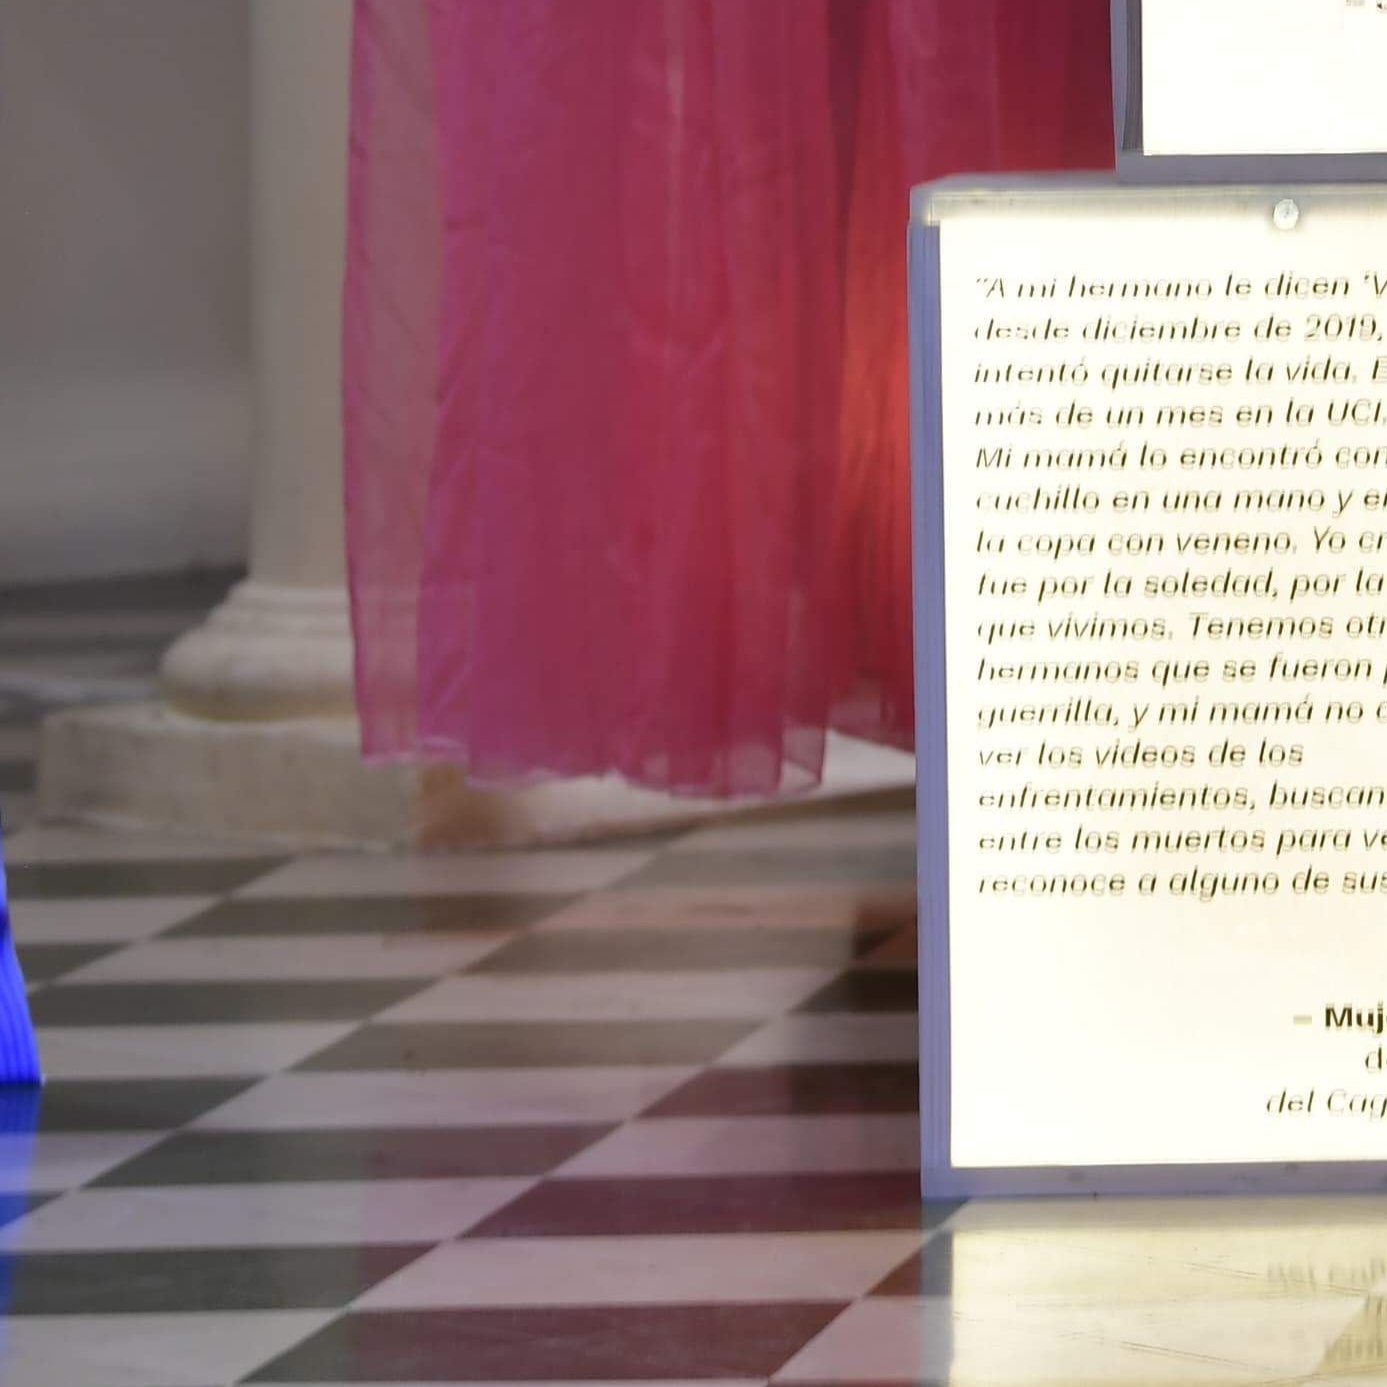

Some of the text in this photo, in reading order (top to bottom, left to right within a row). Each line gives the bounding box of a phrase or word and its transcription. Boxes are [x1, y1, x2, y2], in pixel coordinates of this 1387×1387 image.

[1067, 273, 1213, 301] hermano
[1224, 271, 1253, 298] le
[1263, 269, 1351, 300] dicen
[973, 317, 1070, 342] desde
[1081, 314, 1242, 343] diciembre
[1253, 312, 1293, 343] de
[1303, 313, 1384, 343] 2019,
[973, 357, 1089, 387] intentó
[1100, 357, 1233, 392] quitarse
[1244, 356, 1275, 385] la
[1054, 396, 1315, 429] de un mes en la
[1022, 441, 1128, 471] mamá
[1138, 440, 1168, 471] lo
[1178, 437, 1324, 471] encontró
[975, 484, 1103, 514] cuchillo
[1111, 490, 1151, 513] en
[1161, 489, 1223, 514] una
[1232, 489, 1326, 513] mano
[975, 529, 1006, 554] la
[1016, 533, 1097, 562] copa
[1107, 533, 1165, 556] con
[1312, 525, 1347, 555] Yo
[977, 571, 1028, 597] fue
[1036, 575, 1095, 607] por
[1103, 568, 1133, 599] la
[1143, 566, 1279, 600] soledad,
[1288, 573, 1347, 604] por
[1354, 565, 1385, 597] la
[976, 620, 1036, 647] que
[1188, 612, 1335, 641] Tenemos
[976, 656, 1140, 684] hermanos
[1151, 659, 1211, 690] que
[1268, 652, 1373, 682] fueron
[976, 696, 1120, 730] guerrilla,
[1208, 693, 1314, 726] mamá
[978, 736, 1305, 769] ver los videos de los
[978, 780, 1257, 814] enfrentamientos,
[978, 830, 1063, 854] entre
[1074, 823, 1121, 854] los
[1130, 825, 1266, 854] muertos
[1275, 828, 1352, 860] para
[978, 873, 1127, 897] reconoce
[1167, 865, 1281, 903] alguno
[1291, 863, 1331, 896] de
[1265, 1086, 1316, 1116] del
